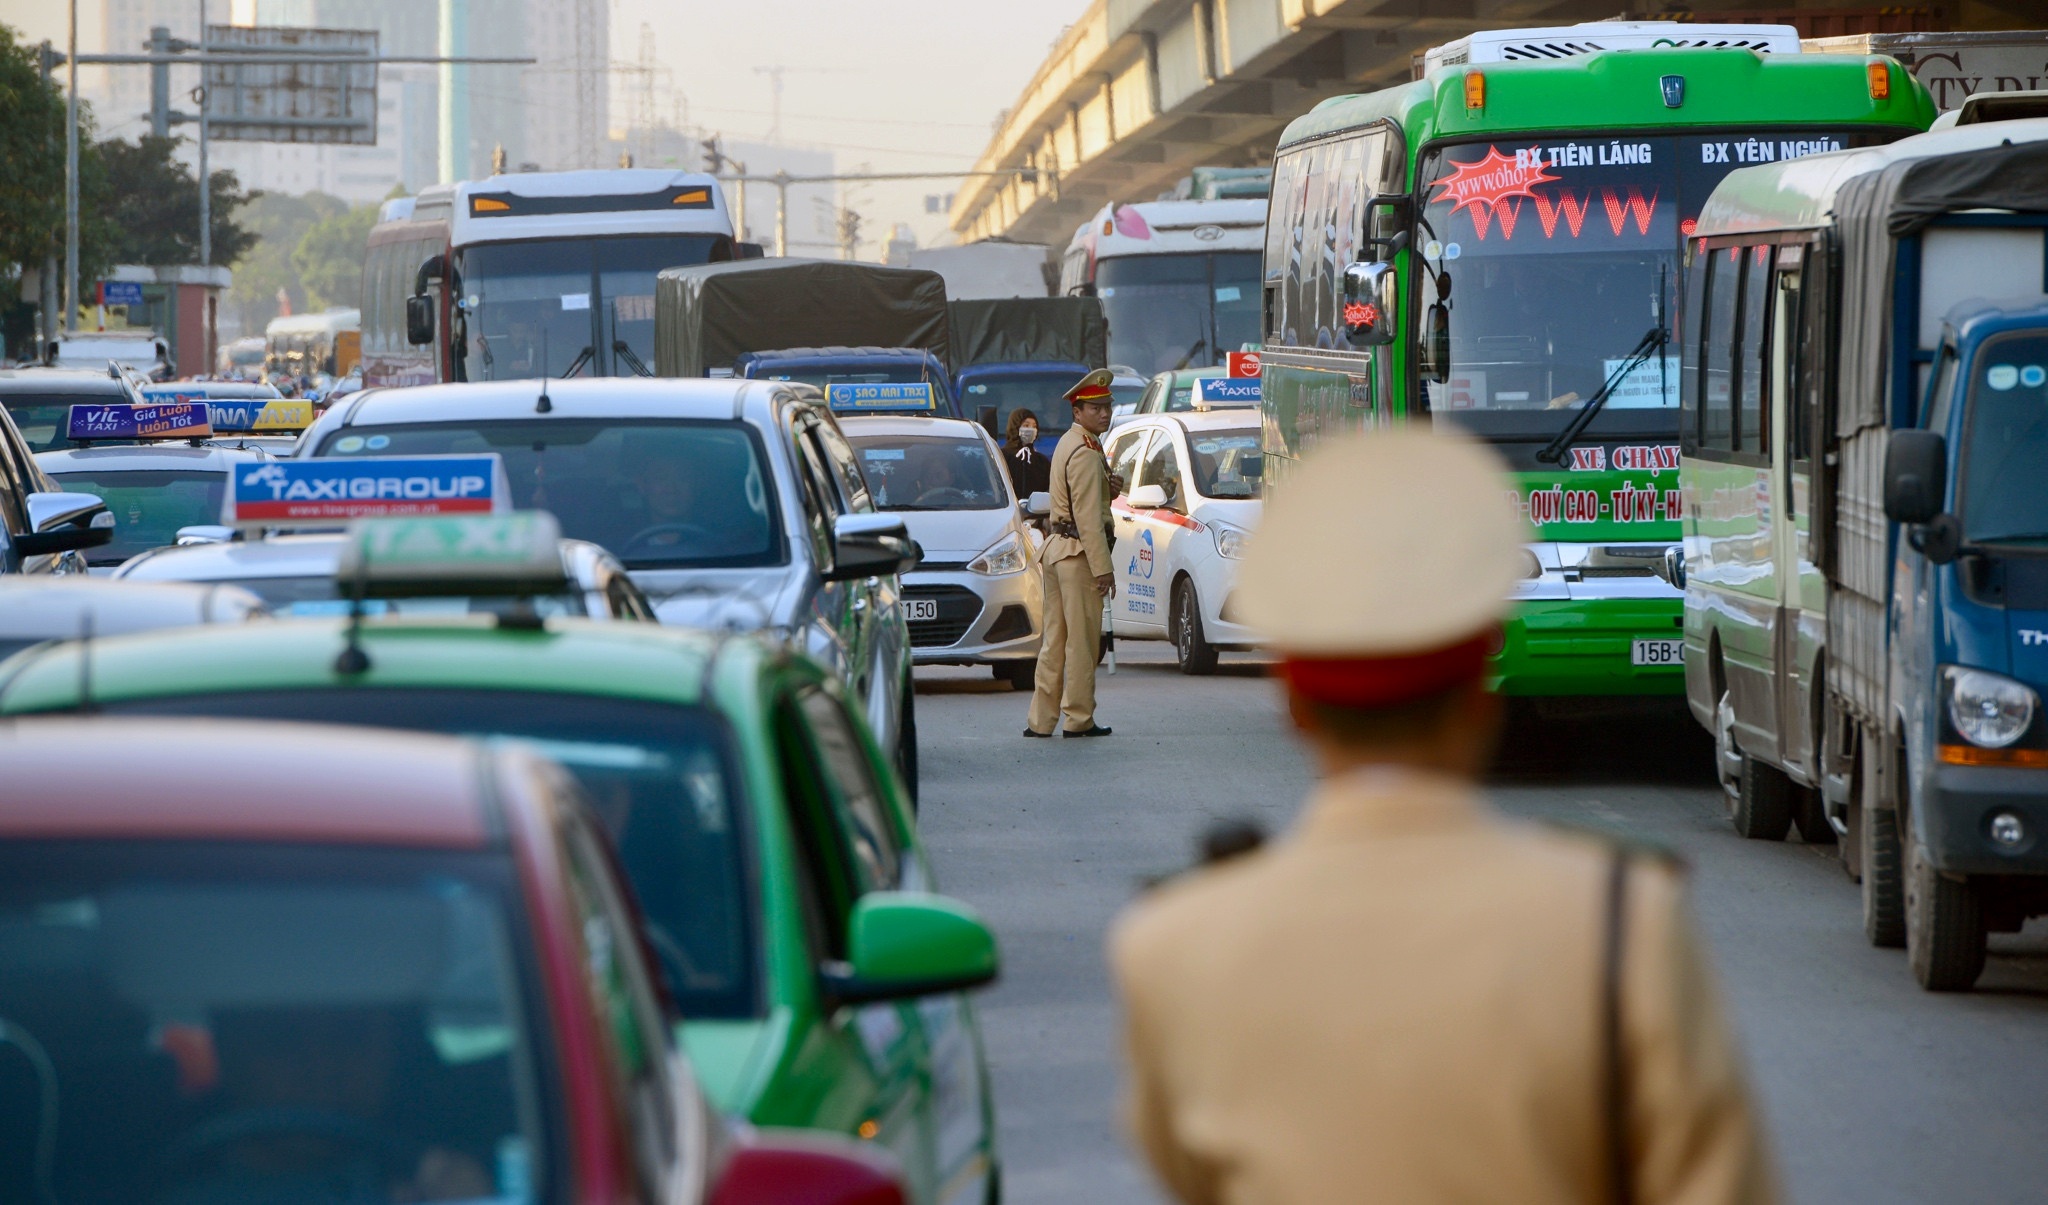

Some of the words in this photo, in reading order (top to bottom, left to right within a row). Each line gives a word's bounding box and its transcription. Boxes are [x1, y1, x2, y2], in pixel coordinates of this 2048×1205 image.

[1515, 147, 1543, 169] BX
[1547, 143, 1593, 168] TIÊN
[1599, 140, 1652, 166] LÃNG
[1701, 142, 1730, 164] BX
[1733, 137, 1775, 163] YÊN
[856, 387, 878, 398] SAO
[881, 387, 901, 397] MAI
[1219, 387, 1261, 396] TAXIG
[134, 409, 157, 422] Giá
[159, 403, 192, 419] Luôn
[255, 407, 301, 424] TAXI
[87, 423, 118, 431] TAXI
[137, 419, 170, 435] Luôn
[171, 414, 192, 428] Tốt
[1570, 445, 1606, 472] XE
[1612, 445, 1680, 477] CHẠY
[266, 475, 486, 500] TAXIGROUP
[1529, 484, 1563, 526] QUÝ
[1564, 490, 1599, 523] CAO
[1611, 480, 1635, 523] TỨ
[1635, 483, 1658, 522] KỲ
[1140, 549, 1152, 561] ECO
[899, 602, 935, 618] 1.50
[2017, 629, 2048, 646] TH
